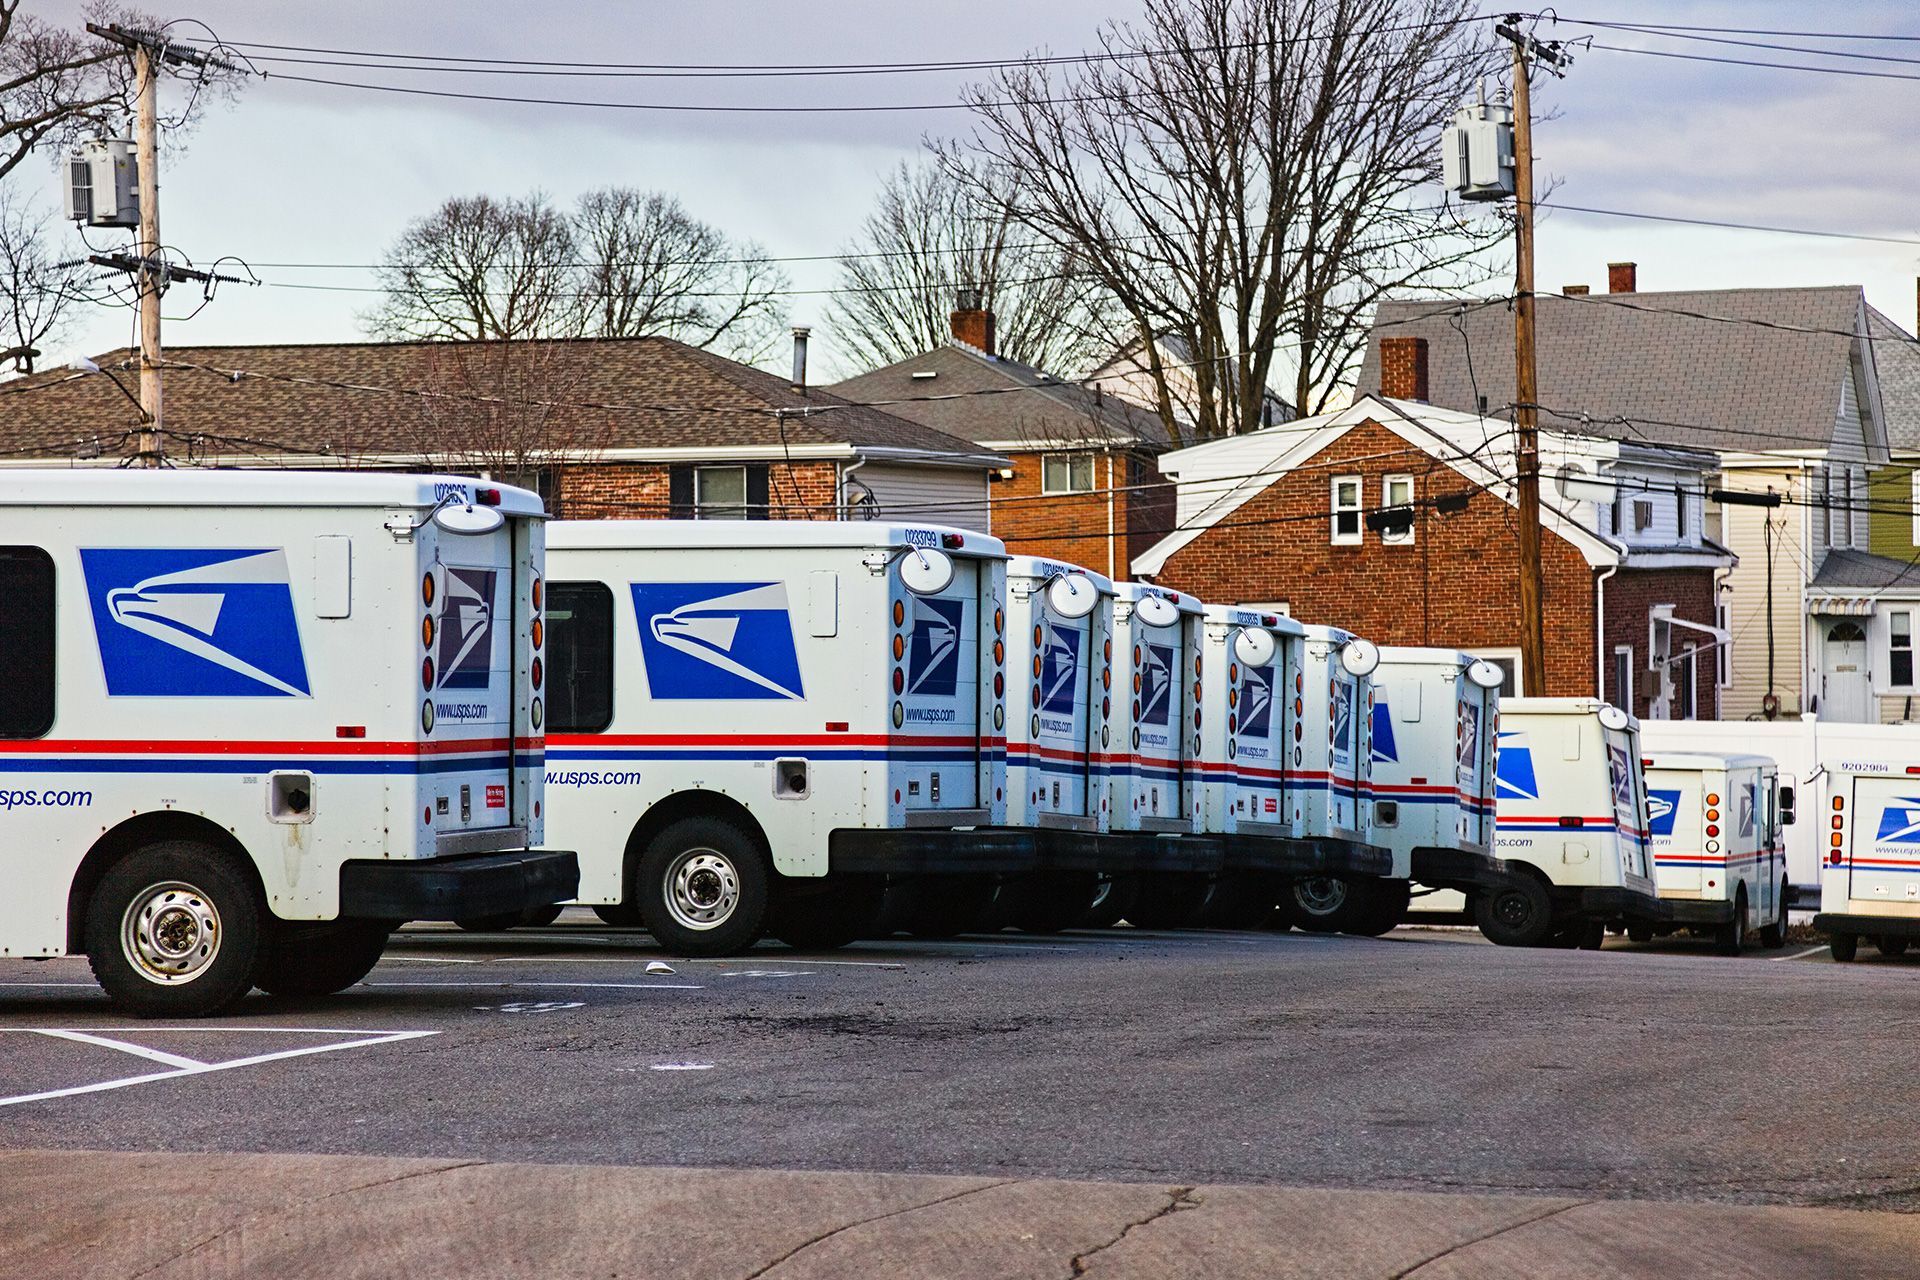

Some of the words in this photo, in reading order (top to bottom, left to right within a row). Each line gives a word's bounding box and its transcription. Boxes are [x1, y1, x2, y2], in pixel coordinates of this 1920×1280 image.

[905, 529, 937, 546] 0233799
[436, 703, 488, 724] www.usps.com
[906, 708, 956, 725] www.usps.com
